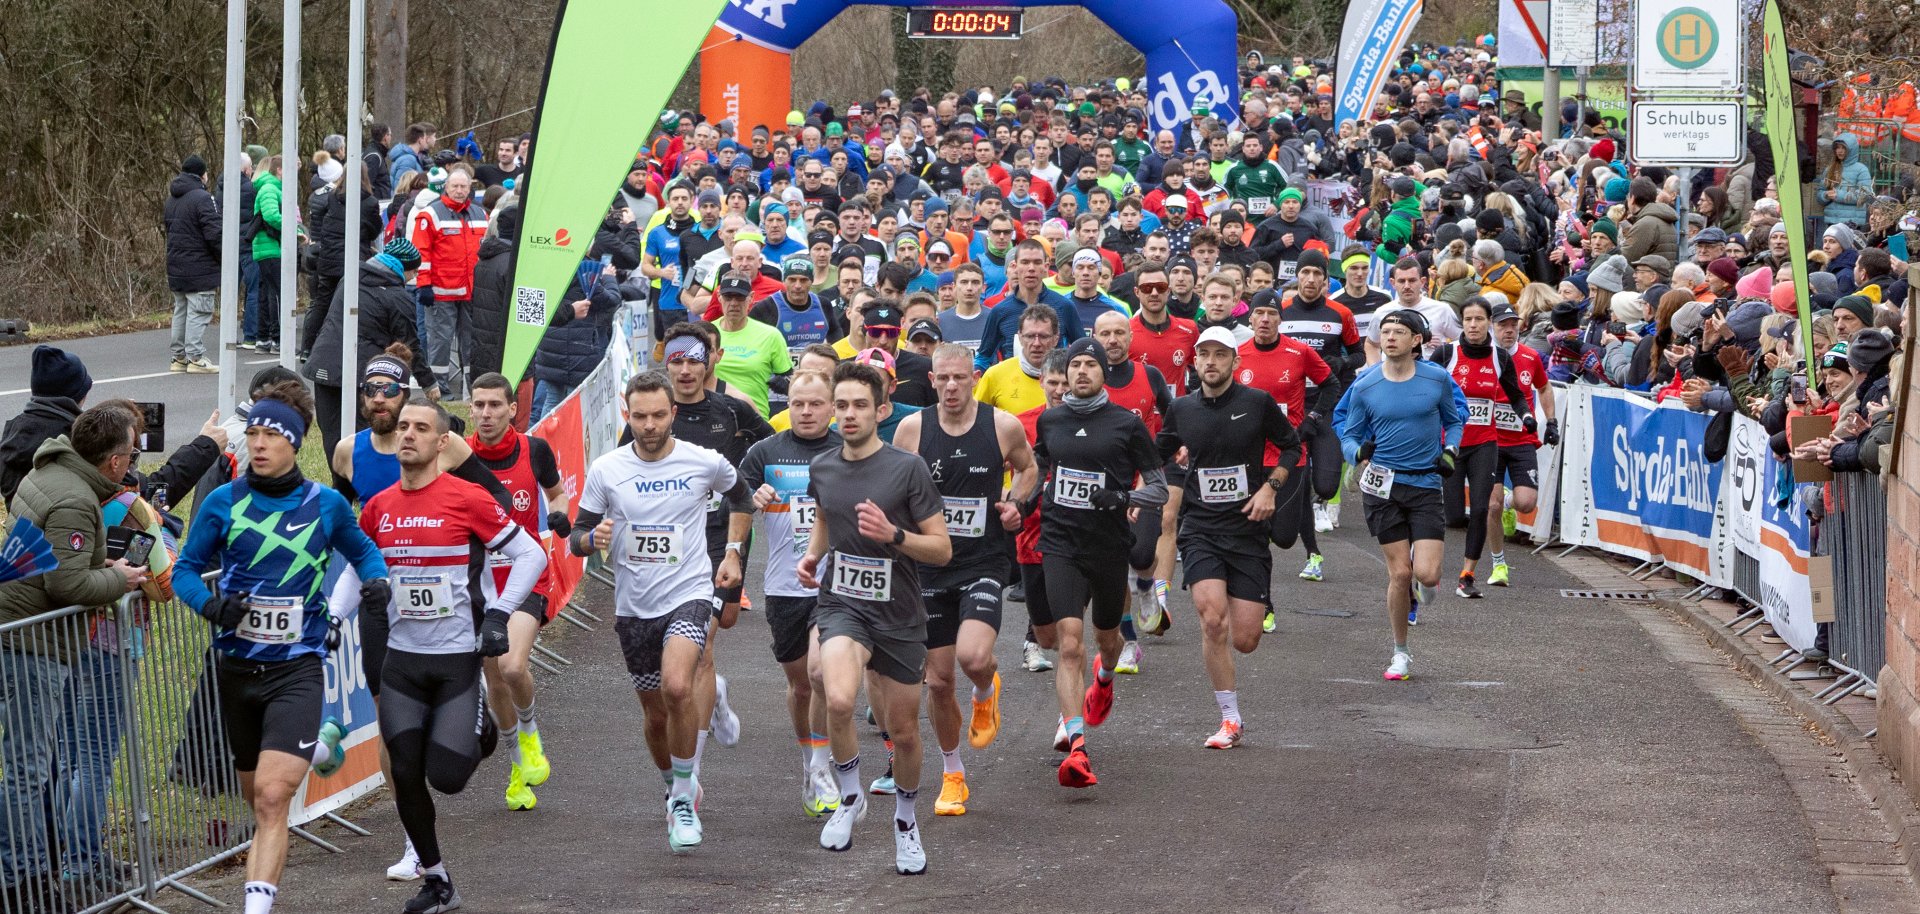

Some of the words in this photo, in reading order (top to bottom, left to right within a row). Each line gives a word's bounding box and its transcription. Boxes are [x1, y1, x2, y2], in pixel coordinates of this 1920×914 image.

[934, 10, 1010, 32] 0:00:04
[723, 83, 739, 142] ank
[1646, 111, 1727, 125] Schulbus
[1663, 131, 1710, 141] werktags
[530, 236, 552, 245] LEX
[787, 333, 821, 341] WITKOWO
[1469, 406, 1488, 417] 324
[1495, 411, 1516, 423] 225
[635, 478, 691, 493] wenk
[1208, 478, 1238, 492] 228
[635, 536, 671, 553] 753
[838, 566, 886, 590] 1765
[410, 589, 434, 607] 50
[249, 609, 289, 631] 616
